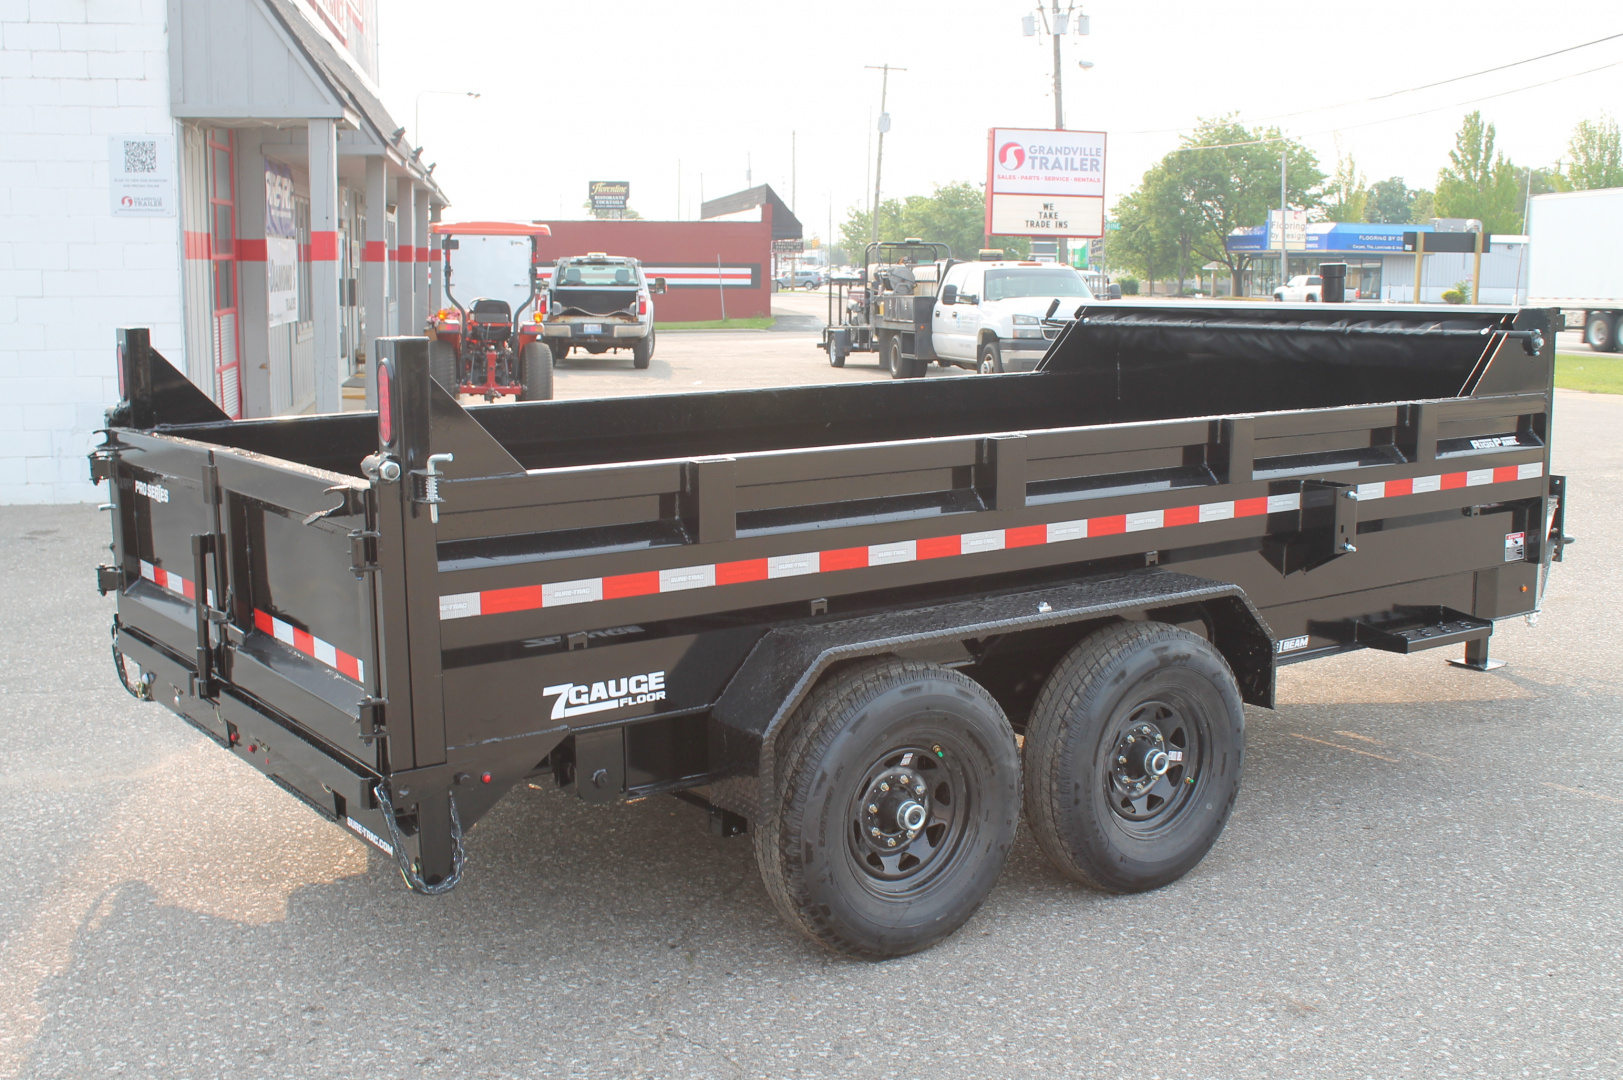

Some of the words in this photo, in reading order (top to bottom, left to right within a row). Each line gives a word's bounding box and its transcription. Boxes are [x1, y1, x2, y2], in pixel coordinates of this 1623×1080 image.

[1028, 145, 1102, 157] GRANDVILLE
[1028, 156, 1100, 172] TRAILER
[591, 182, 627, 195] Florentine
[1039, 211, 1059, 219] TAKE
[1025, 220, 1050, 228] TRADE
[1055, 221, 1068, 229] INS
[135, 480, 146, 496] PRO
[147, 484, 169, 503] SERIES
[878, 549, 906, 558] SURE-TRAC
[778, 561, 809, 570] SURE-TRAC
[670, 574, 704, 584] SURE-TRAC
[554, 588, 590, 598] SURE-TRAC
[1284, 637, 1308, 650] BEAM
[543, 683, 573, 720] 7
[568, 671, 665, 705] GAUGE
[619, 691, 666, 708] FLOOR
[346, 816, 394, 857] SURE-TRAC.COM
